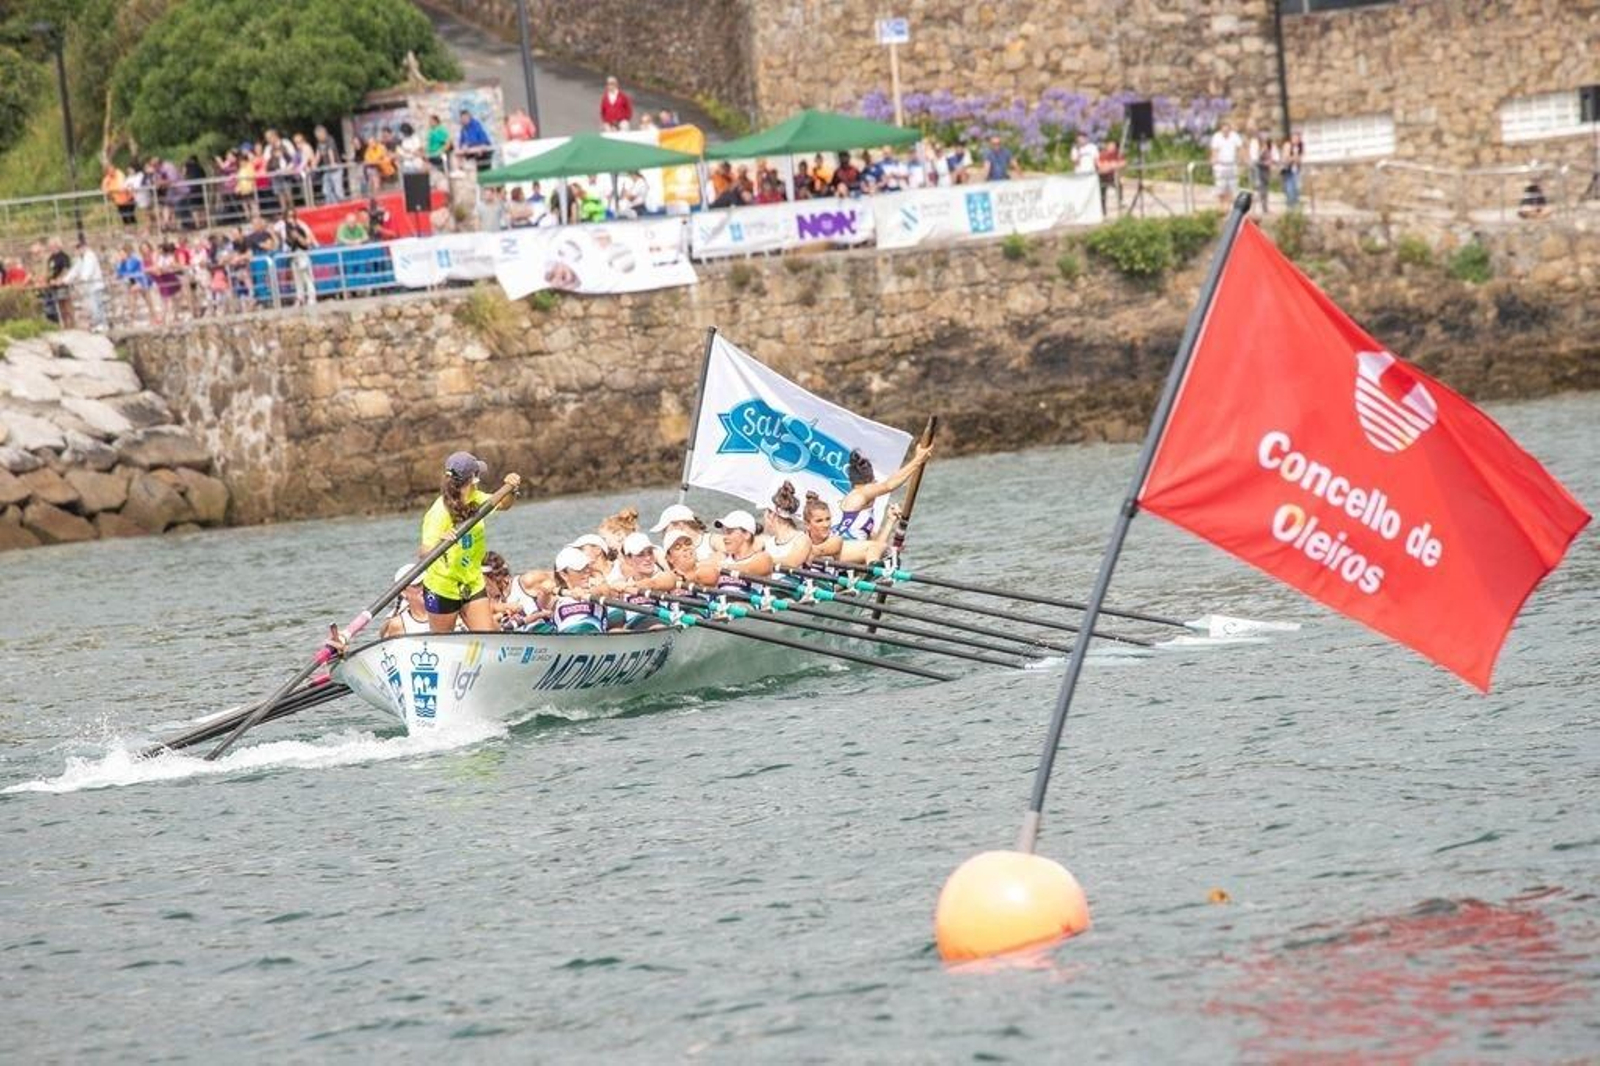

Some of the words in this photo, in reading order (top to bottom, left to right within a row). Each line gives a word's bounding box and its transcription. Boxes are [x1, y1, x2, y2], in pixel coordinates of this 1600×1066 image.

[1258, 430, 1401, 540] Concello
[1405, 522, 1443, 568] de
[1271, 503, 1384, 595] Oleiros
[532, 647, 656, 691] MONDARIZ
